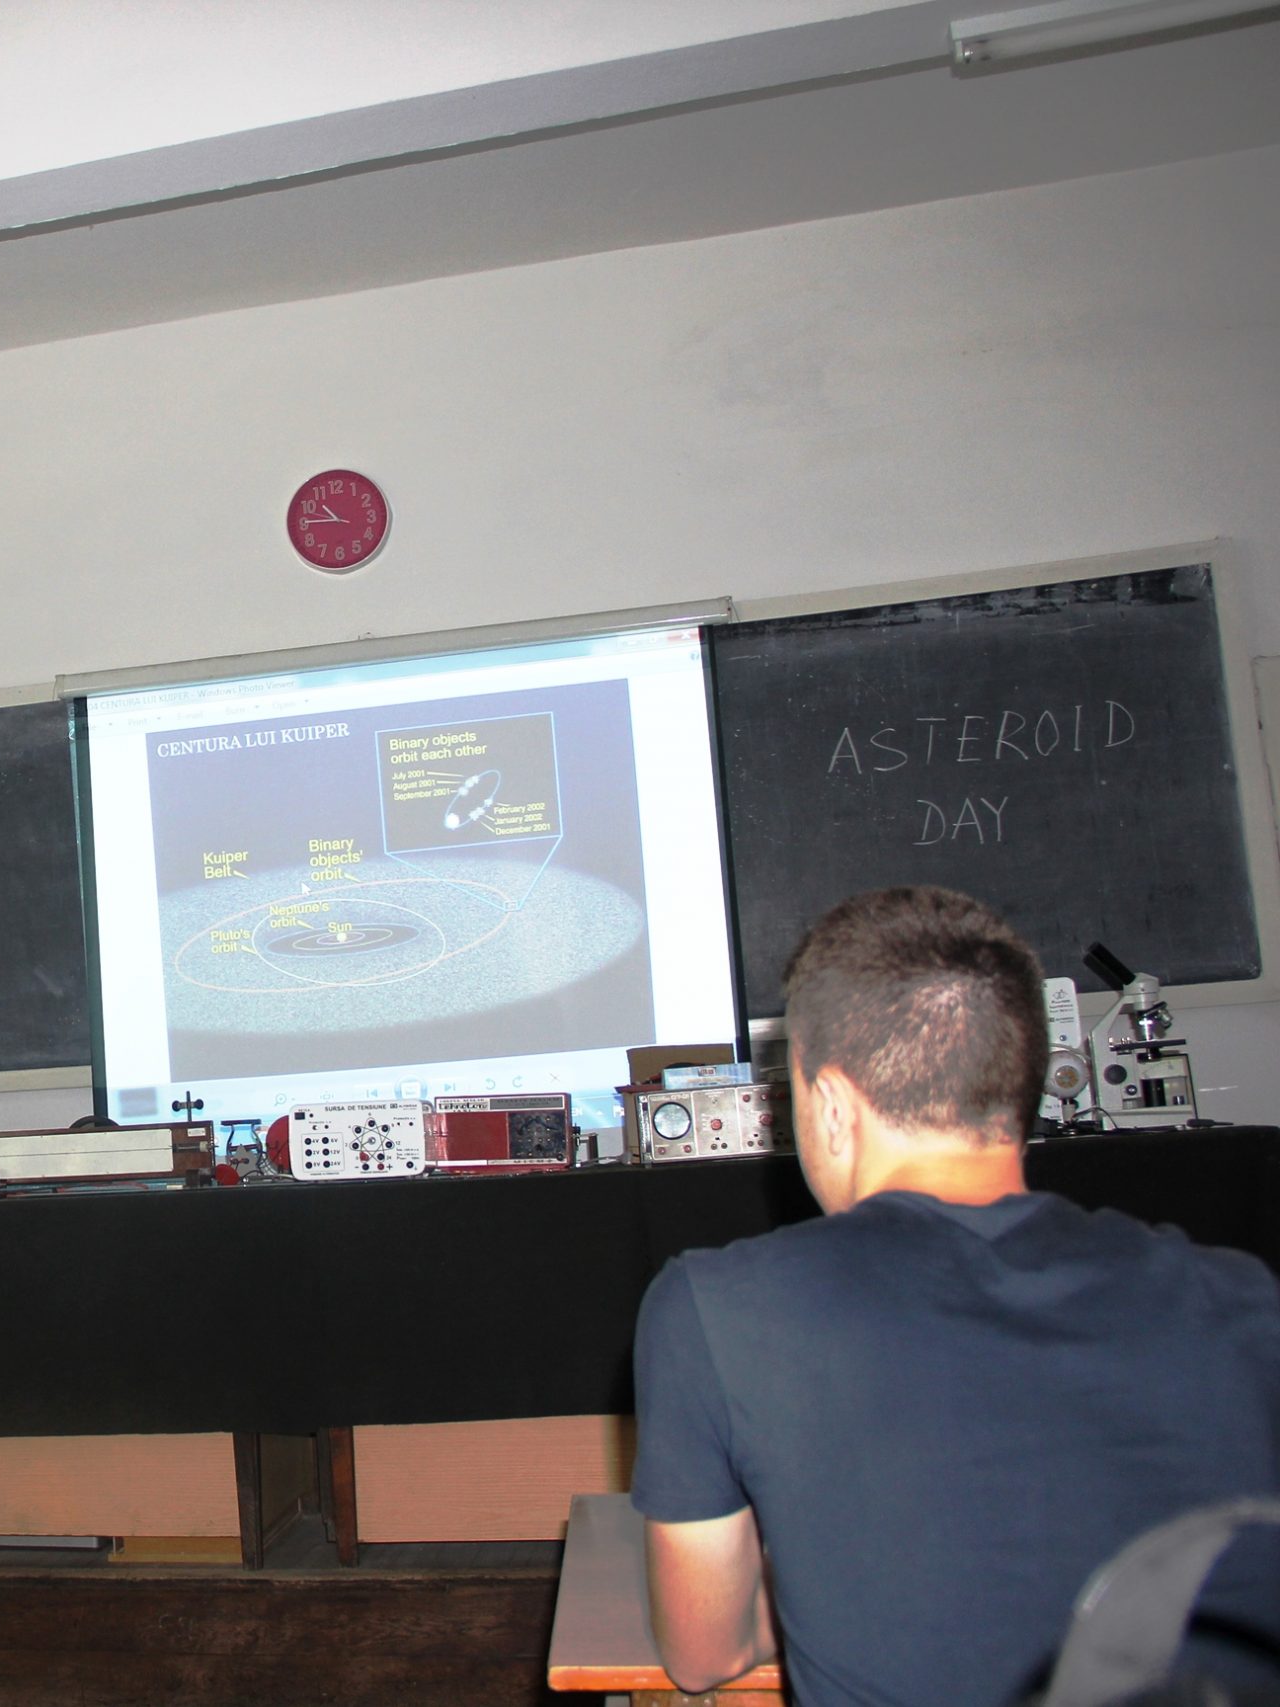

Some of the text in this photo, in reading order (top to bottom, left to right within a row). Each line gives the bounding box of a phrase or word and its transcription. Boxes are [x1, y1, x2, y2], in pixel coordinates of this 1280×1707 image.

[313, 486, 326, 500] 11
[328, 480, 344, 494] 12
[301, 500, 316, 514] 10
[361, 493, 371, 508] 2
[366, 509, 376, 523] 3
[299, 517, 309, 531] 9
[304, 533, 314, 547] 8
[363, 527, 374, 540] 4
[317, 544, 327, 558] 7
[335, 546, 345, 560] 6
[352, 540, 361, 554] 5
[197, 686, 238, 698] Windows
[239, 683, 265, 696] Photo
[266, 680, 295, 692] Viewer
[157, 722, 350, 758] CENTURA LUI KUIPER
[389, 731, 477, 750] Binary objects
[827, 700, 1136, 775] ASTEROID
[391, 744, 488, 764] orbit each other
[392, 769, 426, 781] July 2001
[393, 781, 418, 791] August
[393, 790, 432, 801] September
[494, 802, 545, 815] February 2002
[495, 813, 543, 825] January 2002
[912, 796, 1008, 845] DAY
[495, 823, 551, 836] December 2001
[308, 838, 354, 852] Binary
[203, 850, 249, 866] Kuiper
[309, 849, 363, 867] objects'
[204, 866, 232, 879] Belt
[311, 868, 343, 882] orbit
[269, 901, 330, 917] Neptune's
[270, 916, 297, 928] orbit
[328, 922, 352, 933] Sun
[210, 928, 251, 942] Pluto's
[211, 942, 238, 954] orbit
[357, 1103, 387, 1111] TENSIUNE
